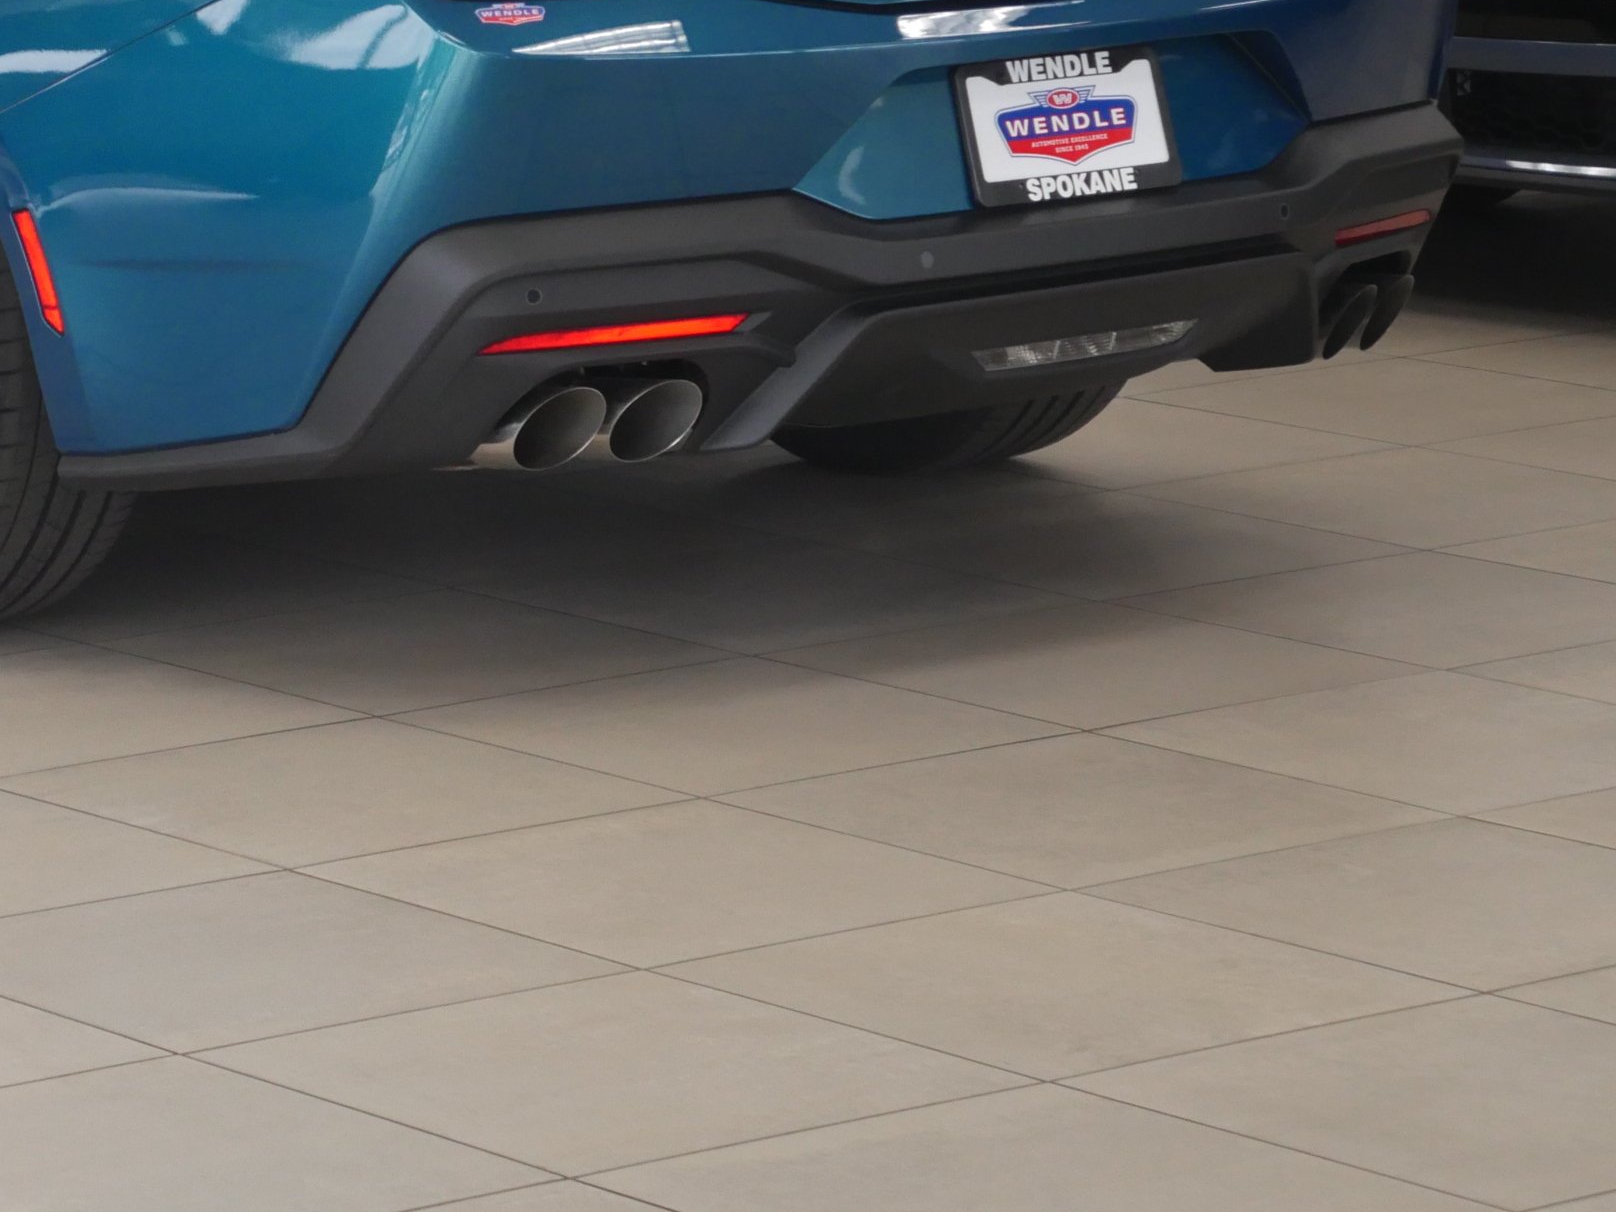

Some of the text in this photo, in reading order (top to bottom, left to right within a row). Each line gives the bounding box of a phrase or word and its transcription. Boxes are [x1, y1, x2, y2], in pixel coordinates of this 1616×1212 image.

[481, 8, 540, 17] WENDLE
[1005, 51, 1113, 83] WENDLE
[1052, 92, 1074, 106] W
[1005, 107, 1127, 137] WENDLE
[1031, 133, 1108, 148] AUTOMOTIVE EXCELLENCE
[1055, 145, 1074, 153] SINCE
[1025, 167, 1138, 203] SPOKANE
